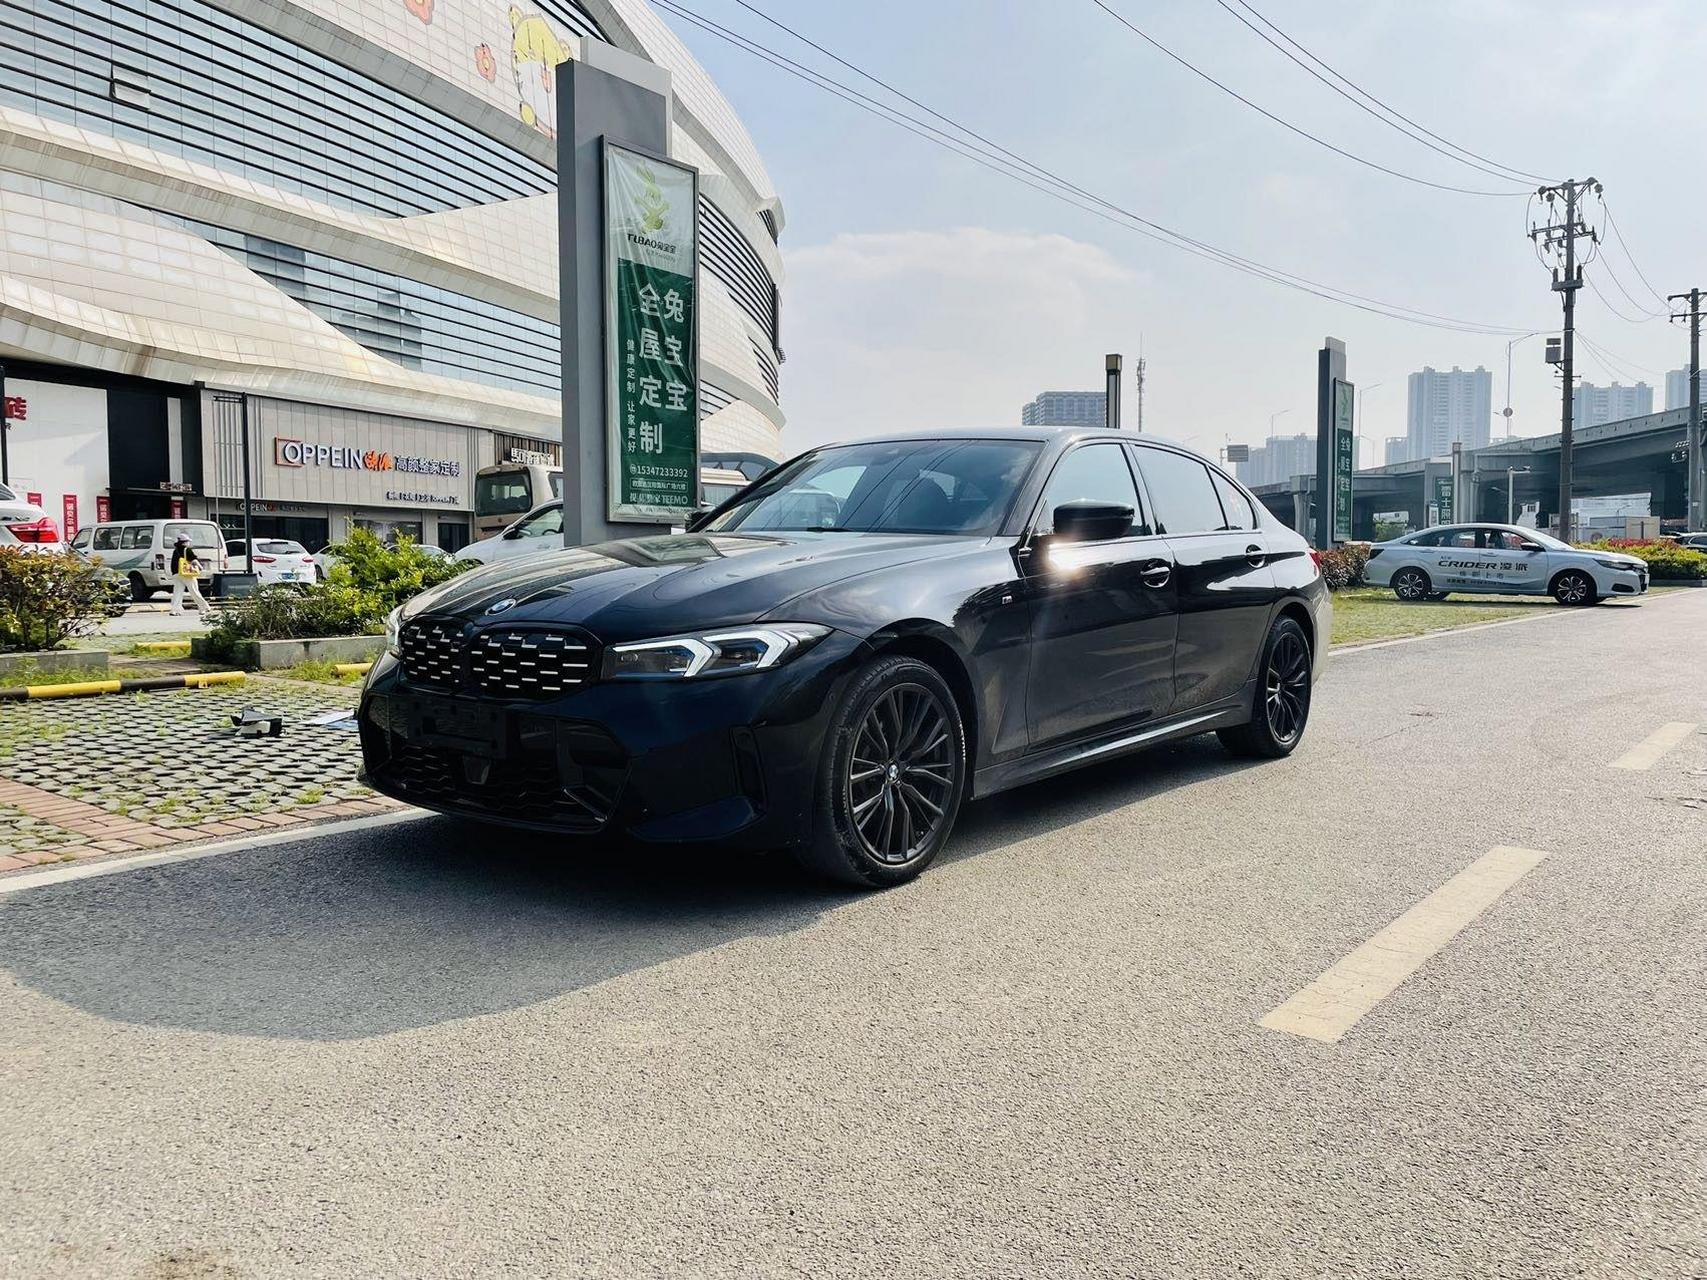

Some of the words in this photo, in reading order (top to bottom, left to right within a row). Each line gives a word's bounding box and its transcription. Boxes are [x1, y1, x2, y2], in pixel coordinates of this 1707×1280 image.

[664, 288, 688, 412] 兔宝宝
[639, 283, 664, 454] 全屋定制
[283, 441, 362, 470] OPPEIN
[637, 465, 688, 478] 15347233392
[239, 503, 268, 512] OPEIN
[1438, 560, 1497, 570] CRIDER
[1500, 562, 1529, 571] 凌派
